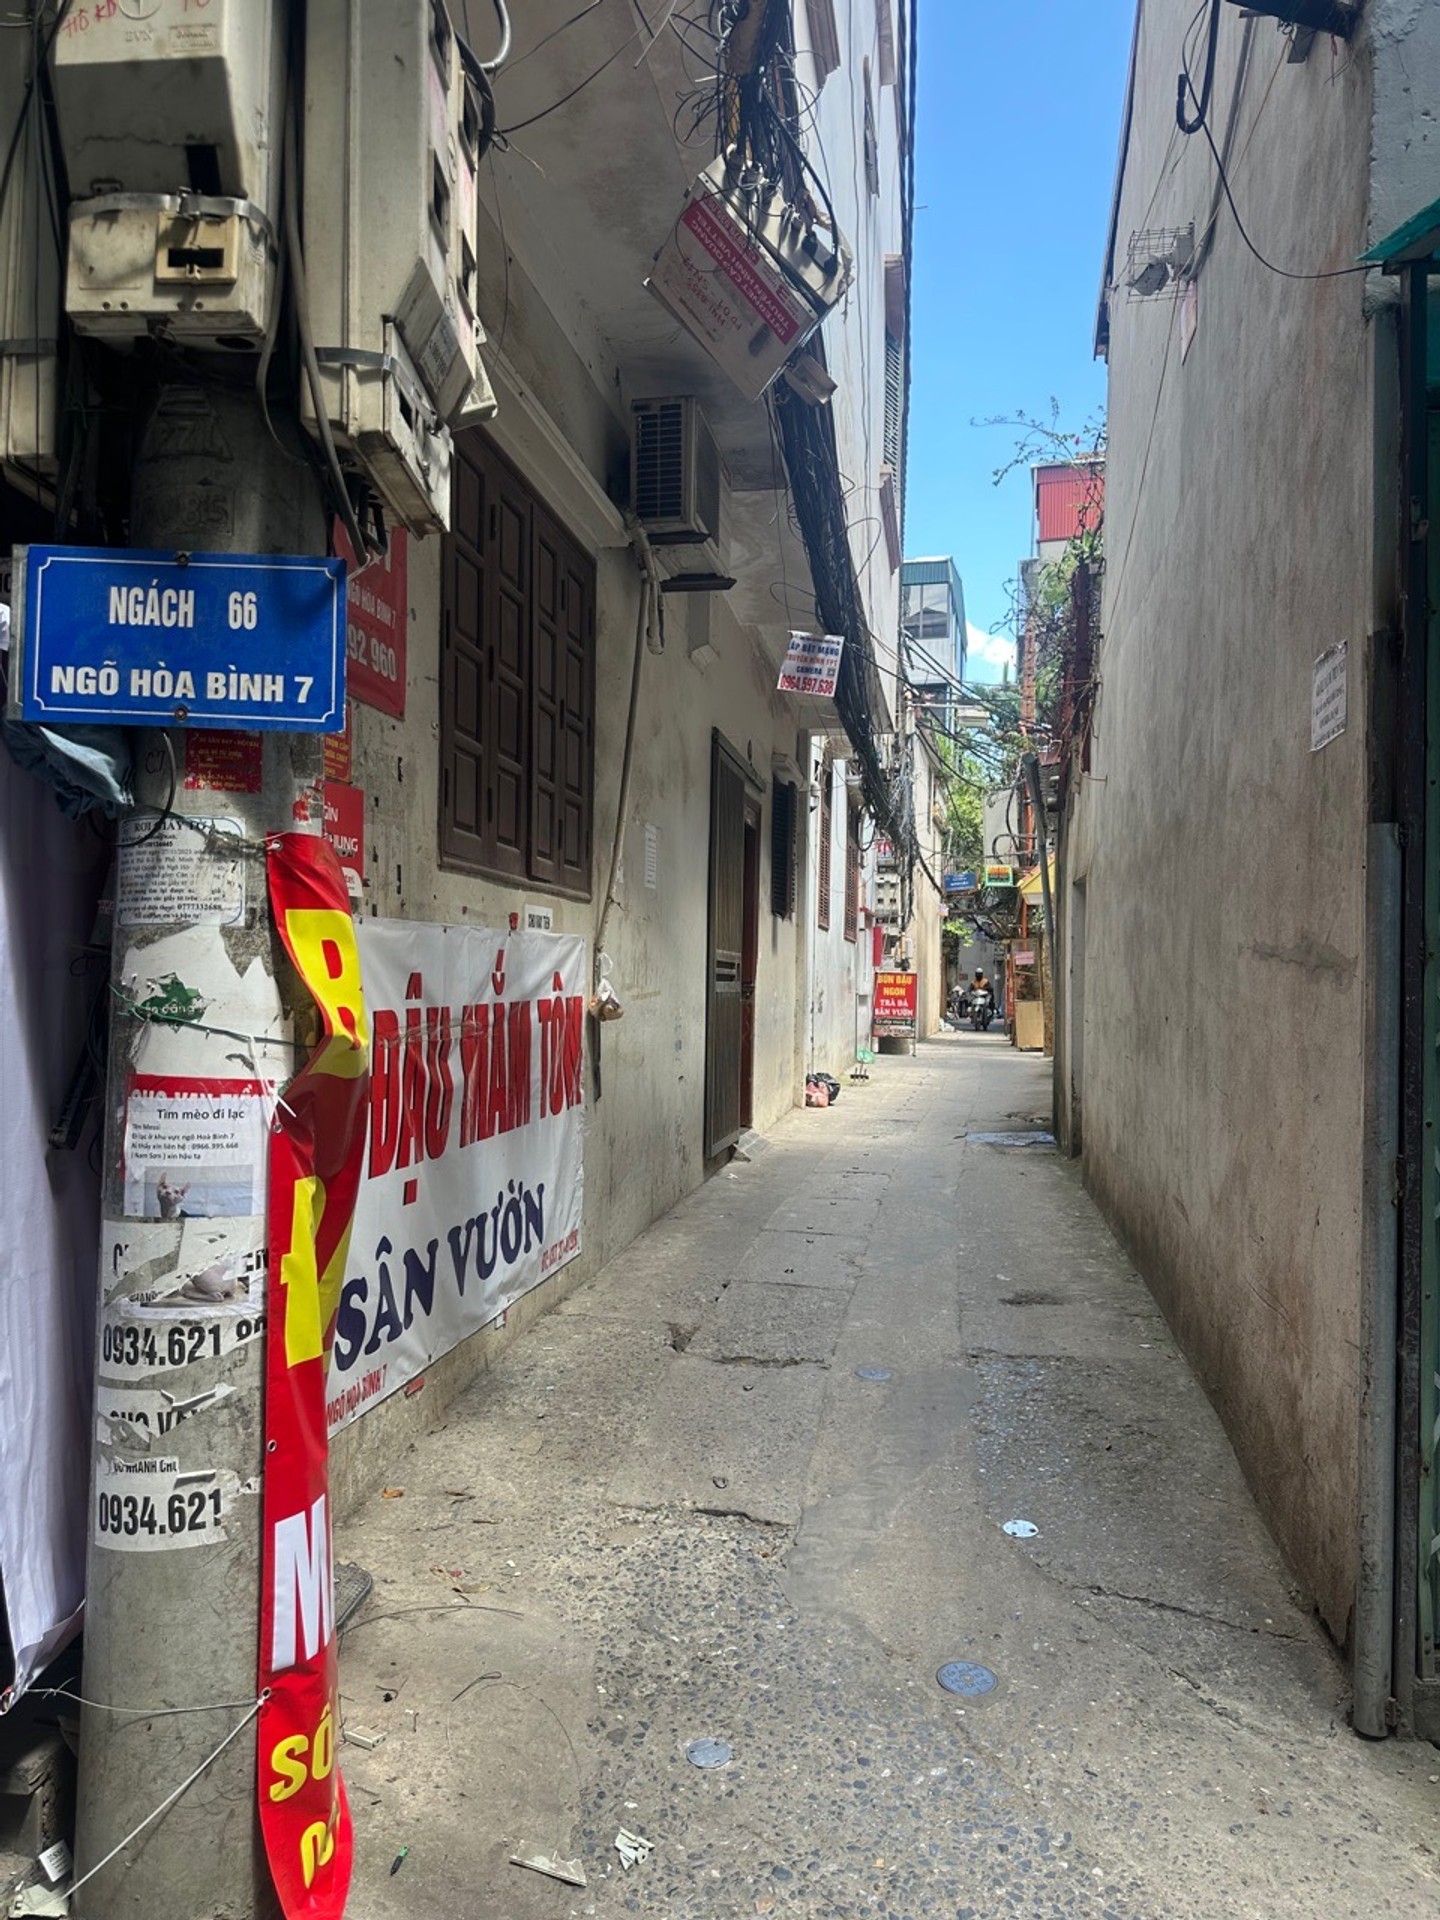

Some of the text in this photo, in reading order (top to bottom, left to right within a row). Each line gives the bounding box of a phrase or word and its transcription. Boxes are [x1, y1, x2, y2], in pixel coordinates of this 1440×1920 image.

[689, 219, 724, 260] QUANG
[693, 210, 733, 257] VIETTEL
[740, 281, 786, 335] INTERNET
[109, 580, 257, 630] NGÁCH 66
[51, 661, 314, 703] NGÕ HÒA BÌNH 7
[370, 637, 398, 683] 960
[883, 987, 906, 996] NGON
[182, 1108, 210, 1120] mèo
[212, 1108, 225, 1119] đi
[227, 1108, 245, 1121] lạc
[335, 1179, 545, 1371] SÂN VƯỜN
